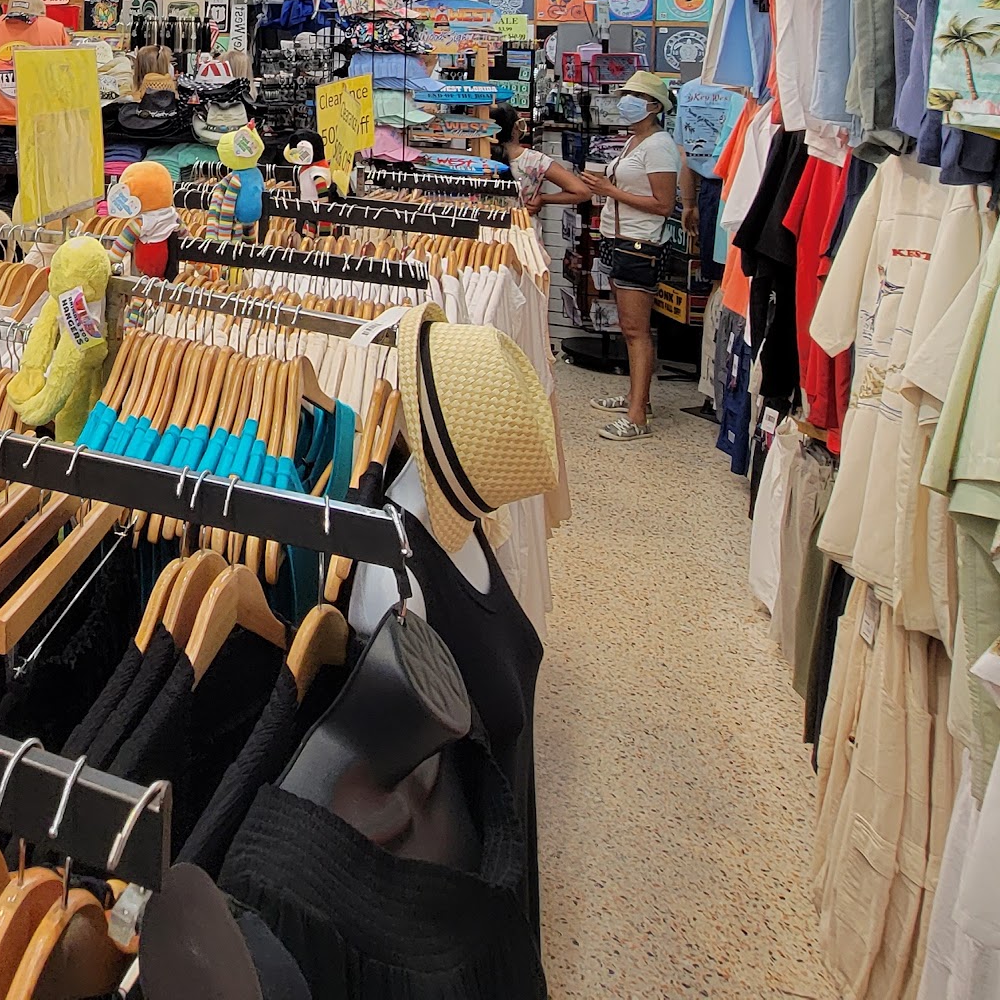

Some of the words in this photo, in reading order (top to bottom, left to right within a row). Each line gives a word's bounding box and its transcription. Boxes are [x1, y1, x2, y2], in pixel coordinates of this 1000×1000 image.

[451, 8, 494, 23] WEST
[446, 122, 490, 131] WEST
[437, 157, 475, 166] WEST
